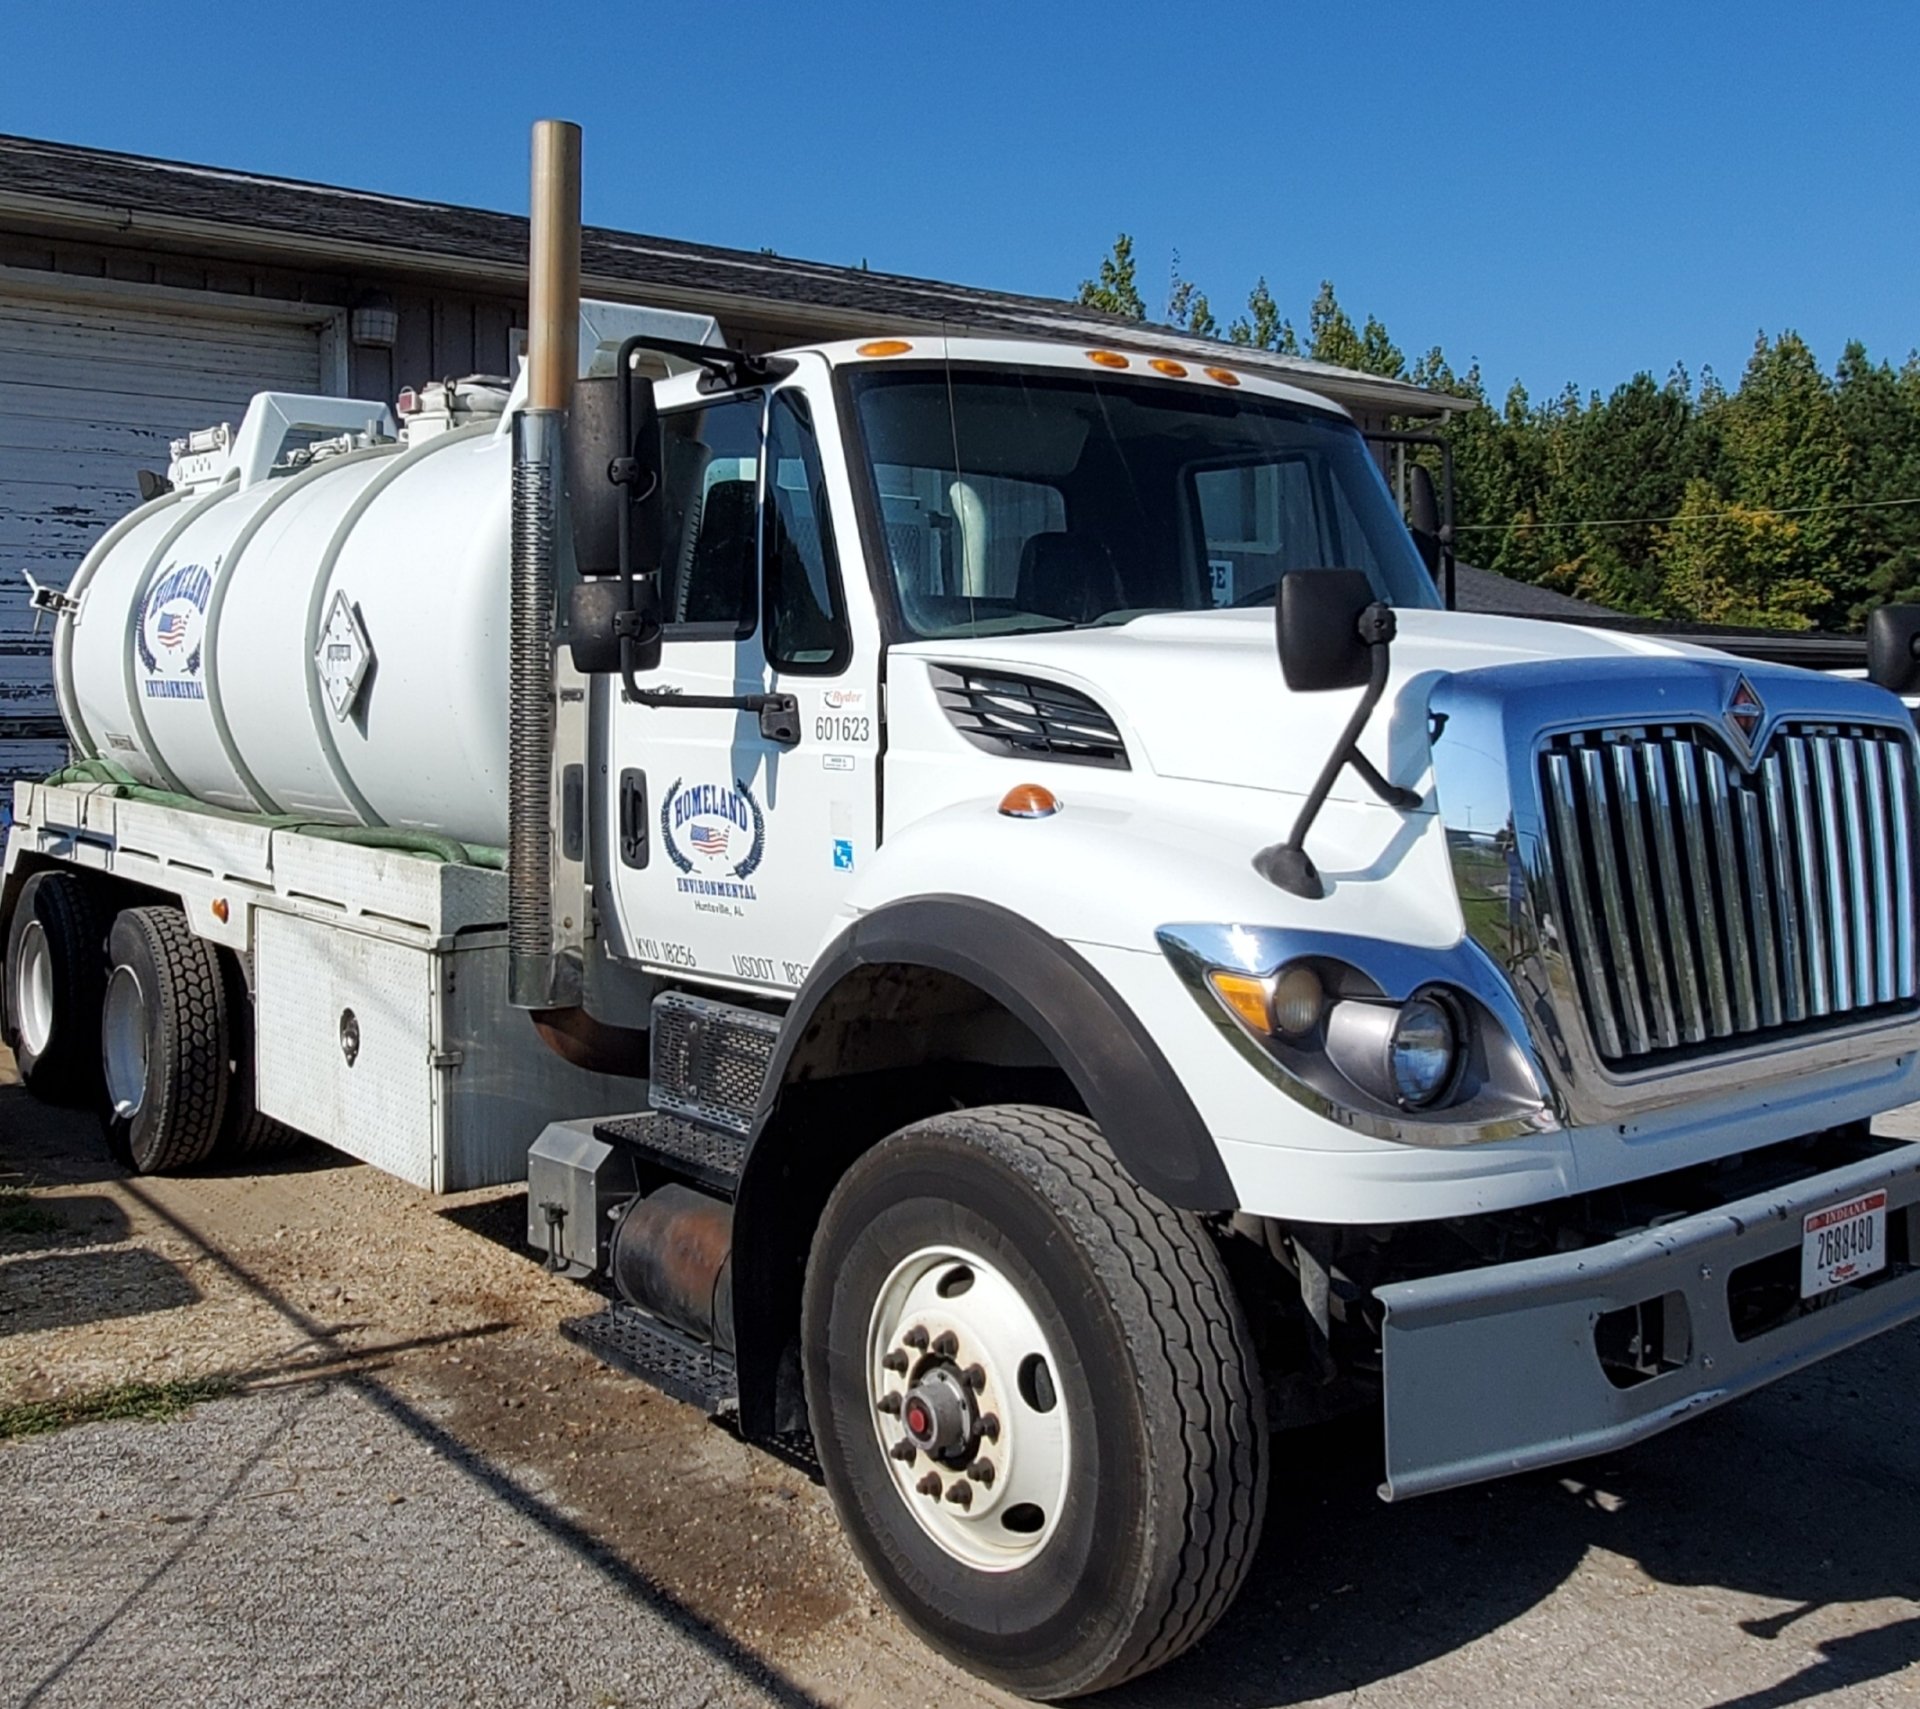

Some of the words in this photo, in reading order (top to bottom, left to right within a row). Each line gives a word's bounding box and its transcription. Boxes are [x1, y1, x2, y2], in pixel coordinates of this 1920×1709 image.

[832, 690, 862, 704] Ryder
[815, 716, 869, 742] 601623
[675, 784, 748, 832] HOMELAND
[676, 877, 757, 901] ENVIRONMENTAL
[635, 937, 660, 960] KYU
[661, 941, 697, 967] 18256
[732, 955, 776, 981] USDOT
[1825, 1200, 1867, 1224] INDIANA
[1817, 1215, 1873, 1270] 2688480
